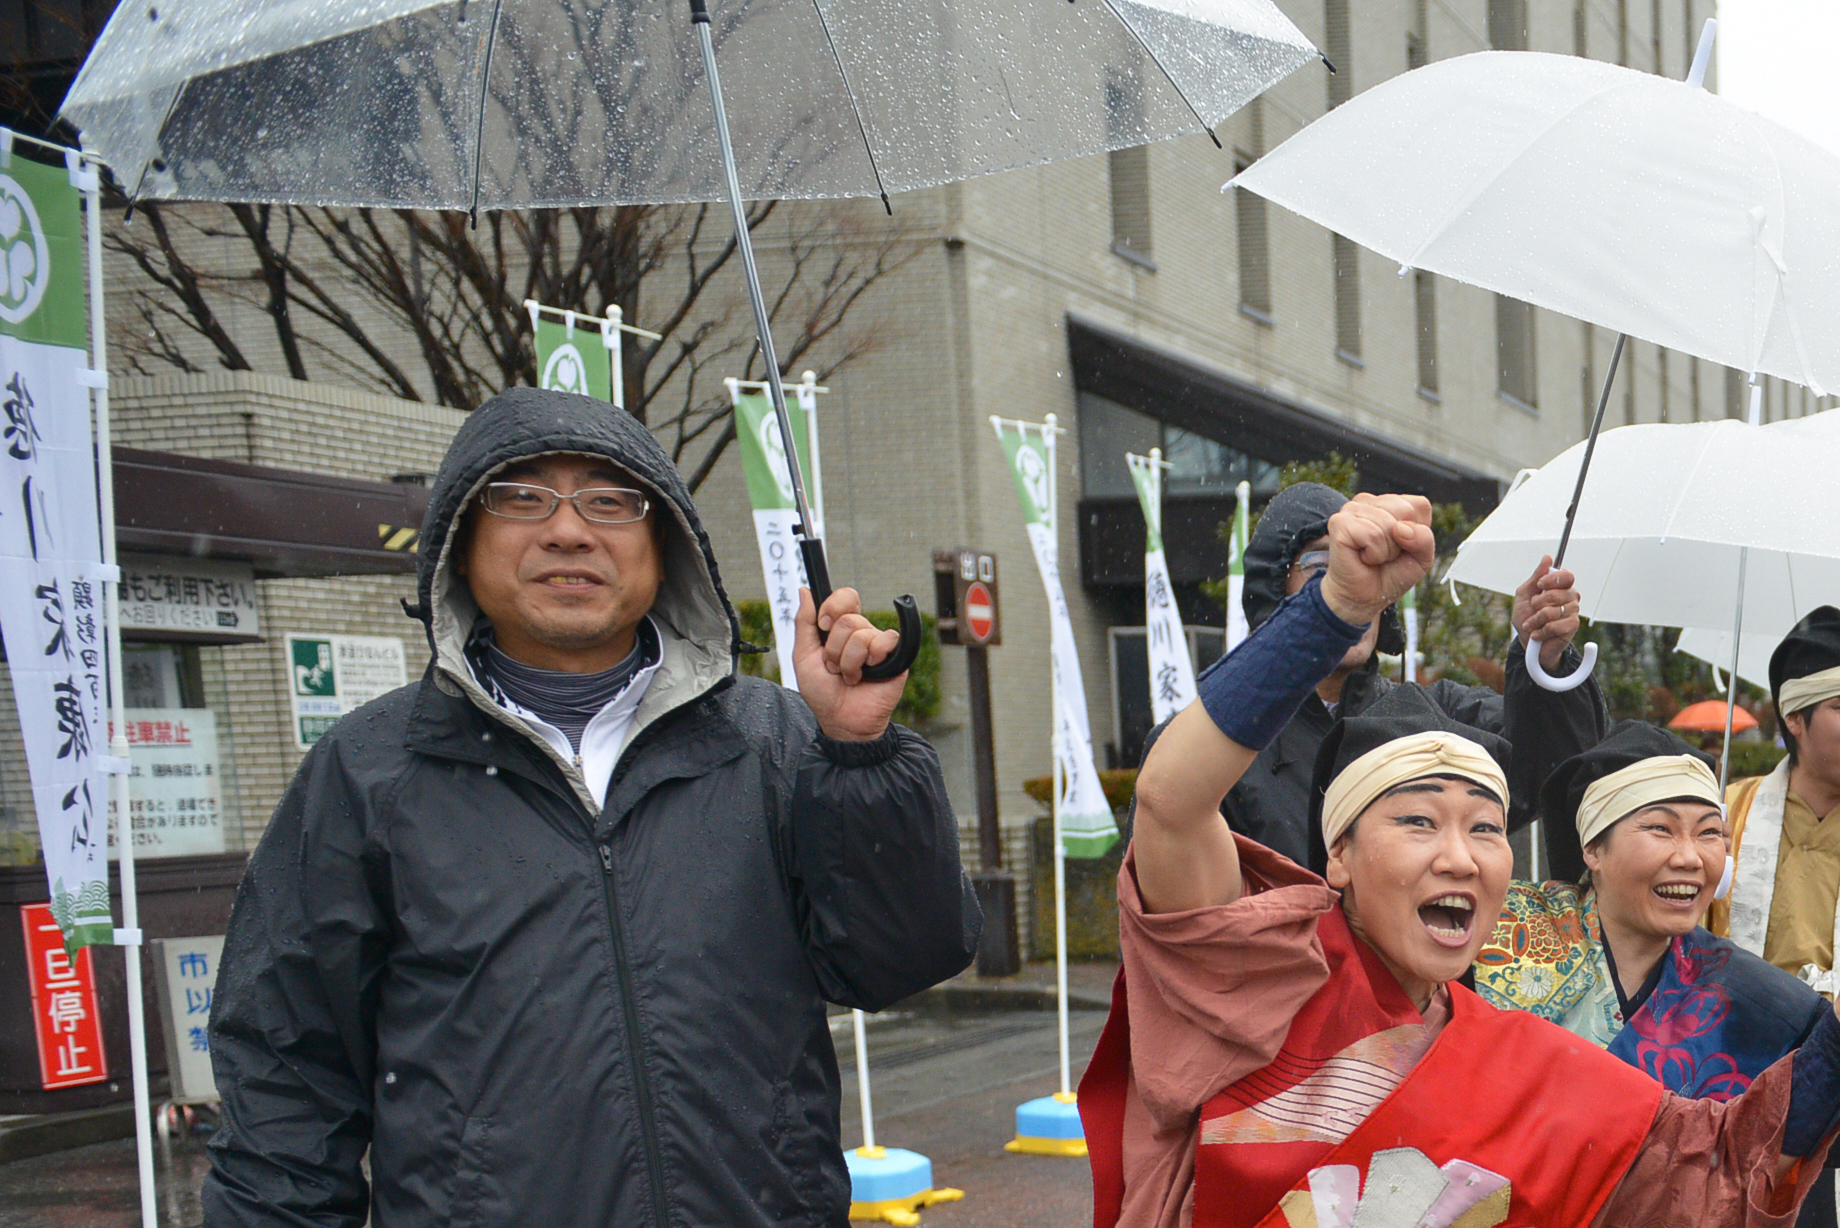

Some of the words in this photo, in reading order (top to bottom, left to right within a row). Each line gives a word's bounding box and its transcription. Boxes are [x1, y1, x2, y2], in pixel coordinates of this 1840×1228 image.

[960, 551, 995, 582] 出口
[1147, 571, 1182, 718] 徳川家
